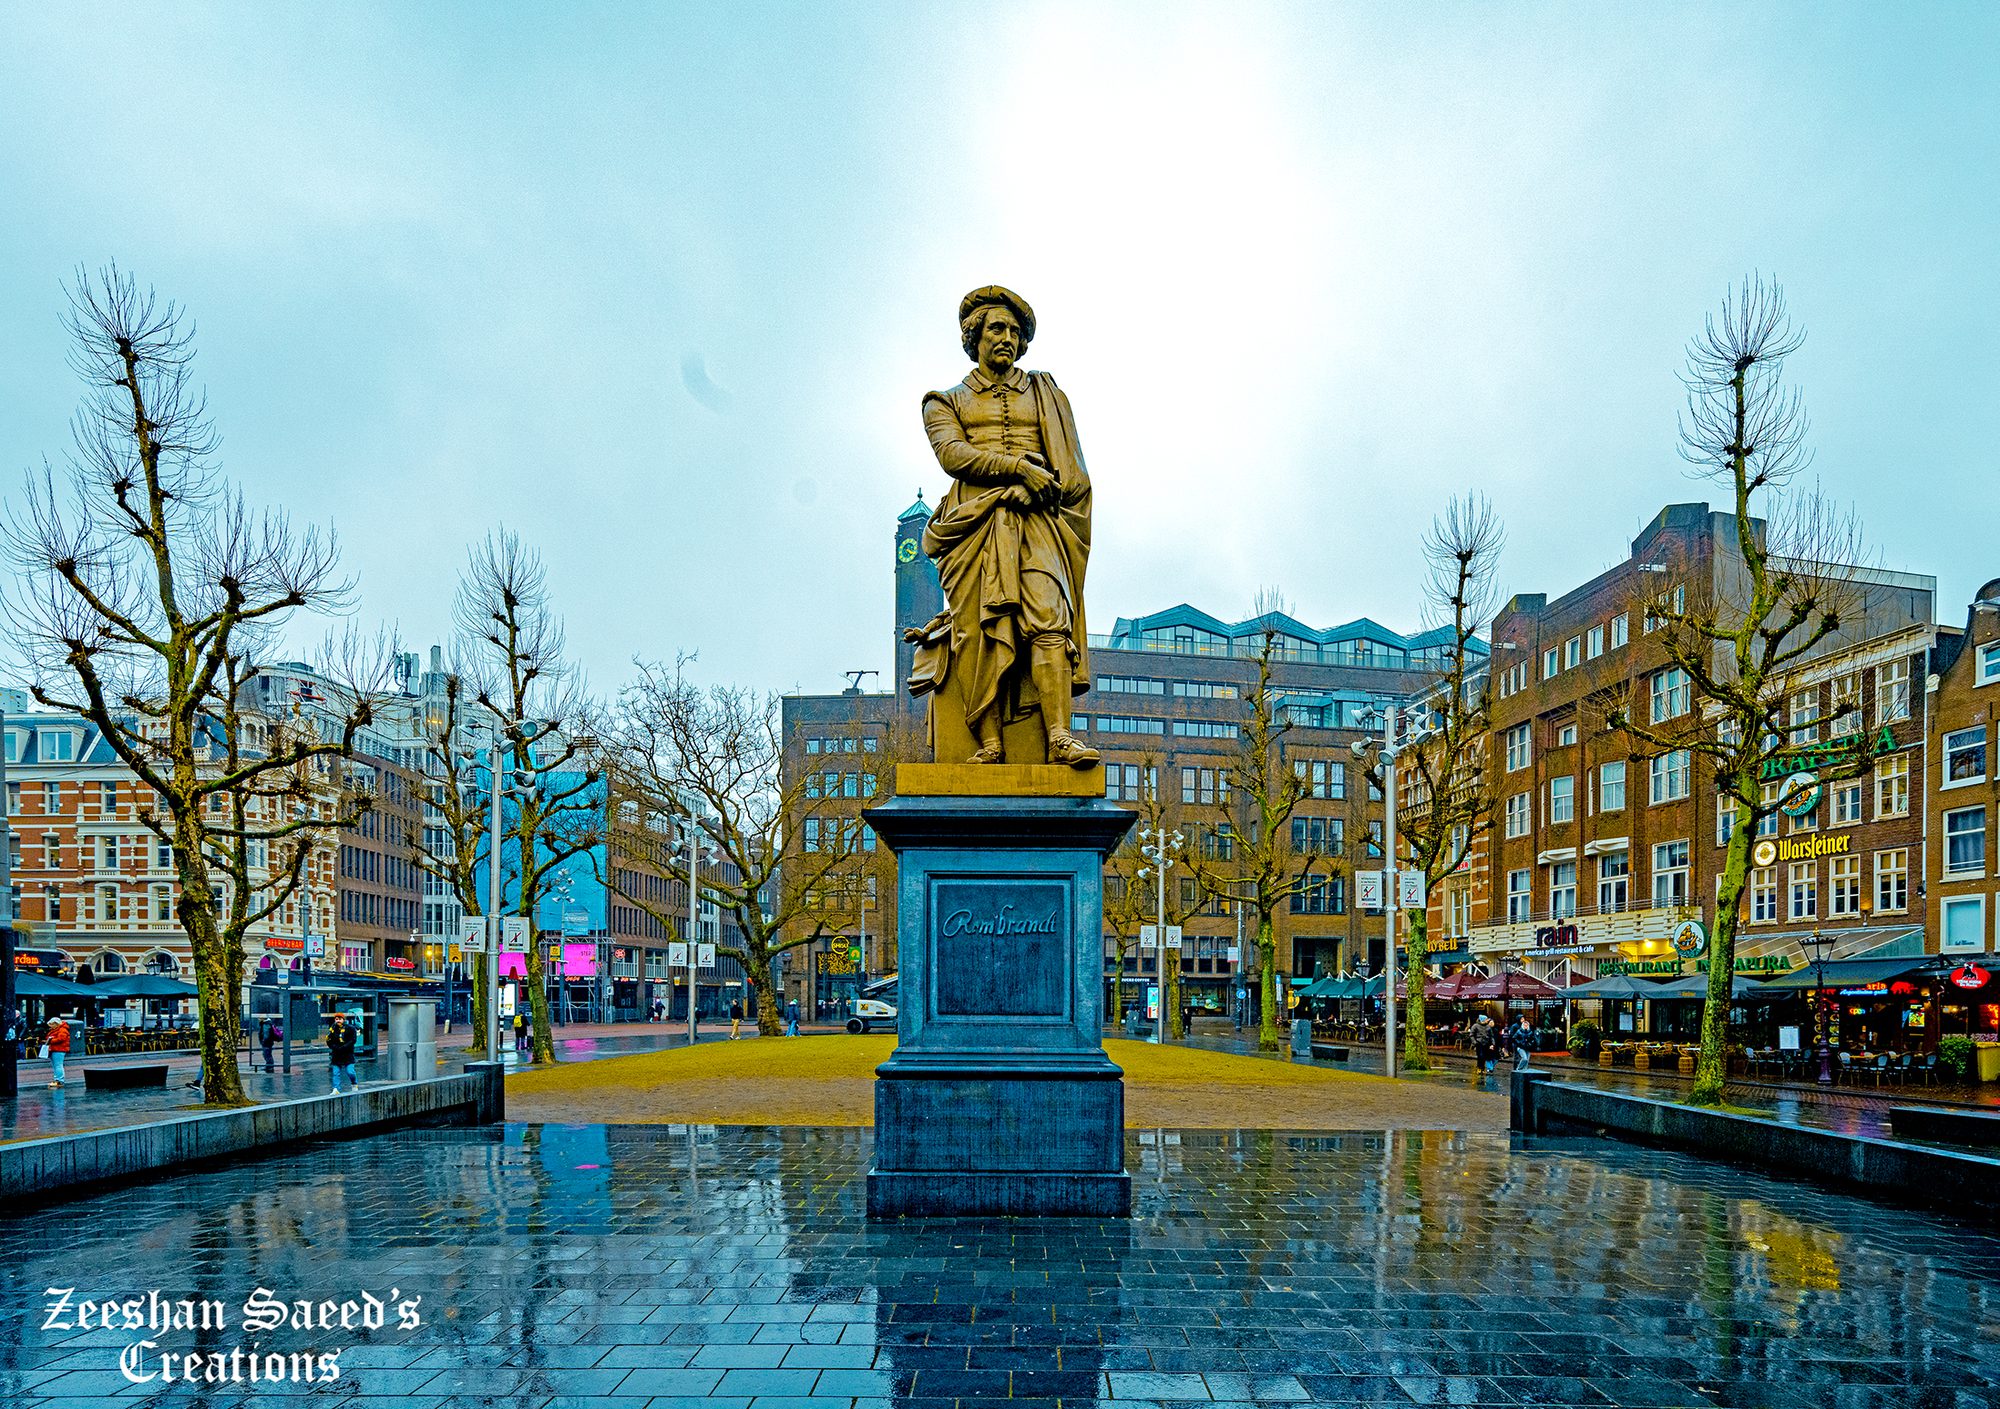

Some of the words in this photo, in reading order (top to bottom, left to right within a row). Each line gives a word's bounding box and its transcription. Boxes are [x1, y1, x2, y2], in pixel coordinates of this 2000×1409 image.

[1779, 832, 1850, 861] Warsteiner
[943, 905, 1057, 937] Rembrandt
[1536, 918, 1579, 947] rain
[1600, 960, 1686, 975] RESTAURANT
[1695, 955, 1794, 972] INAPURA
